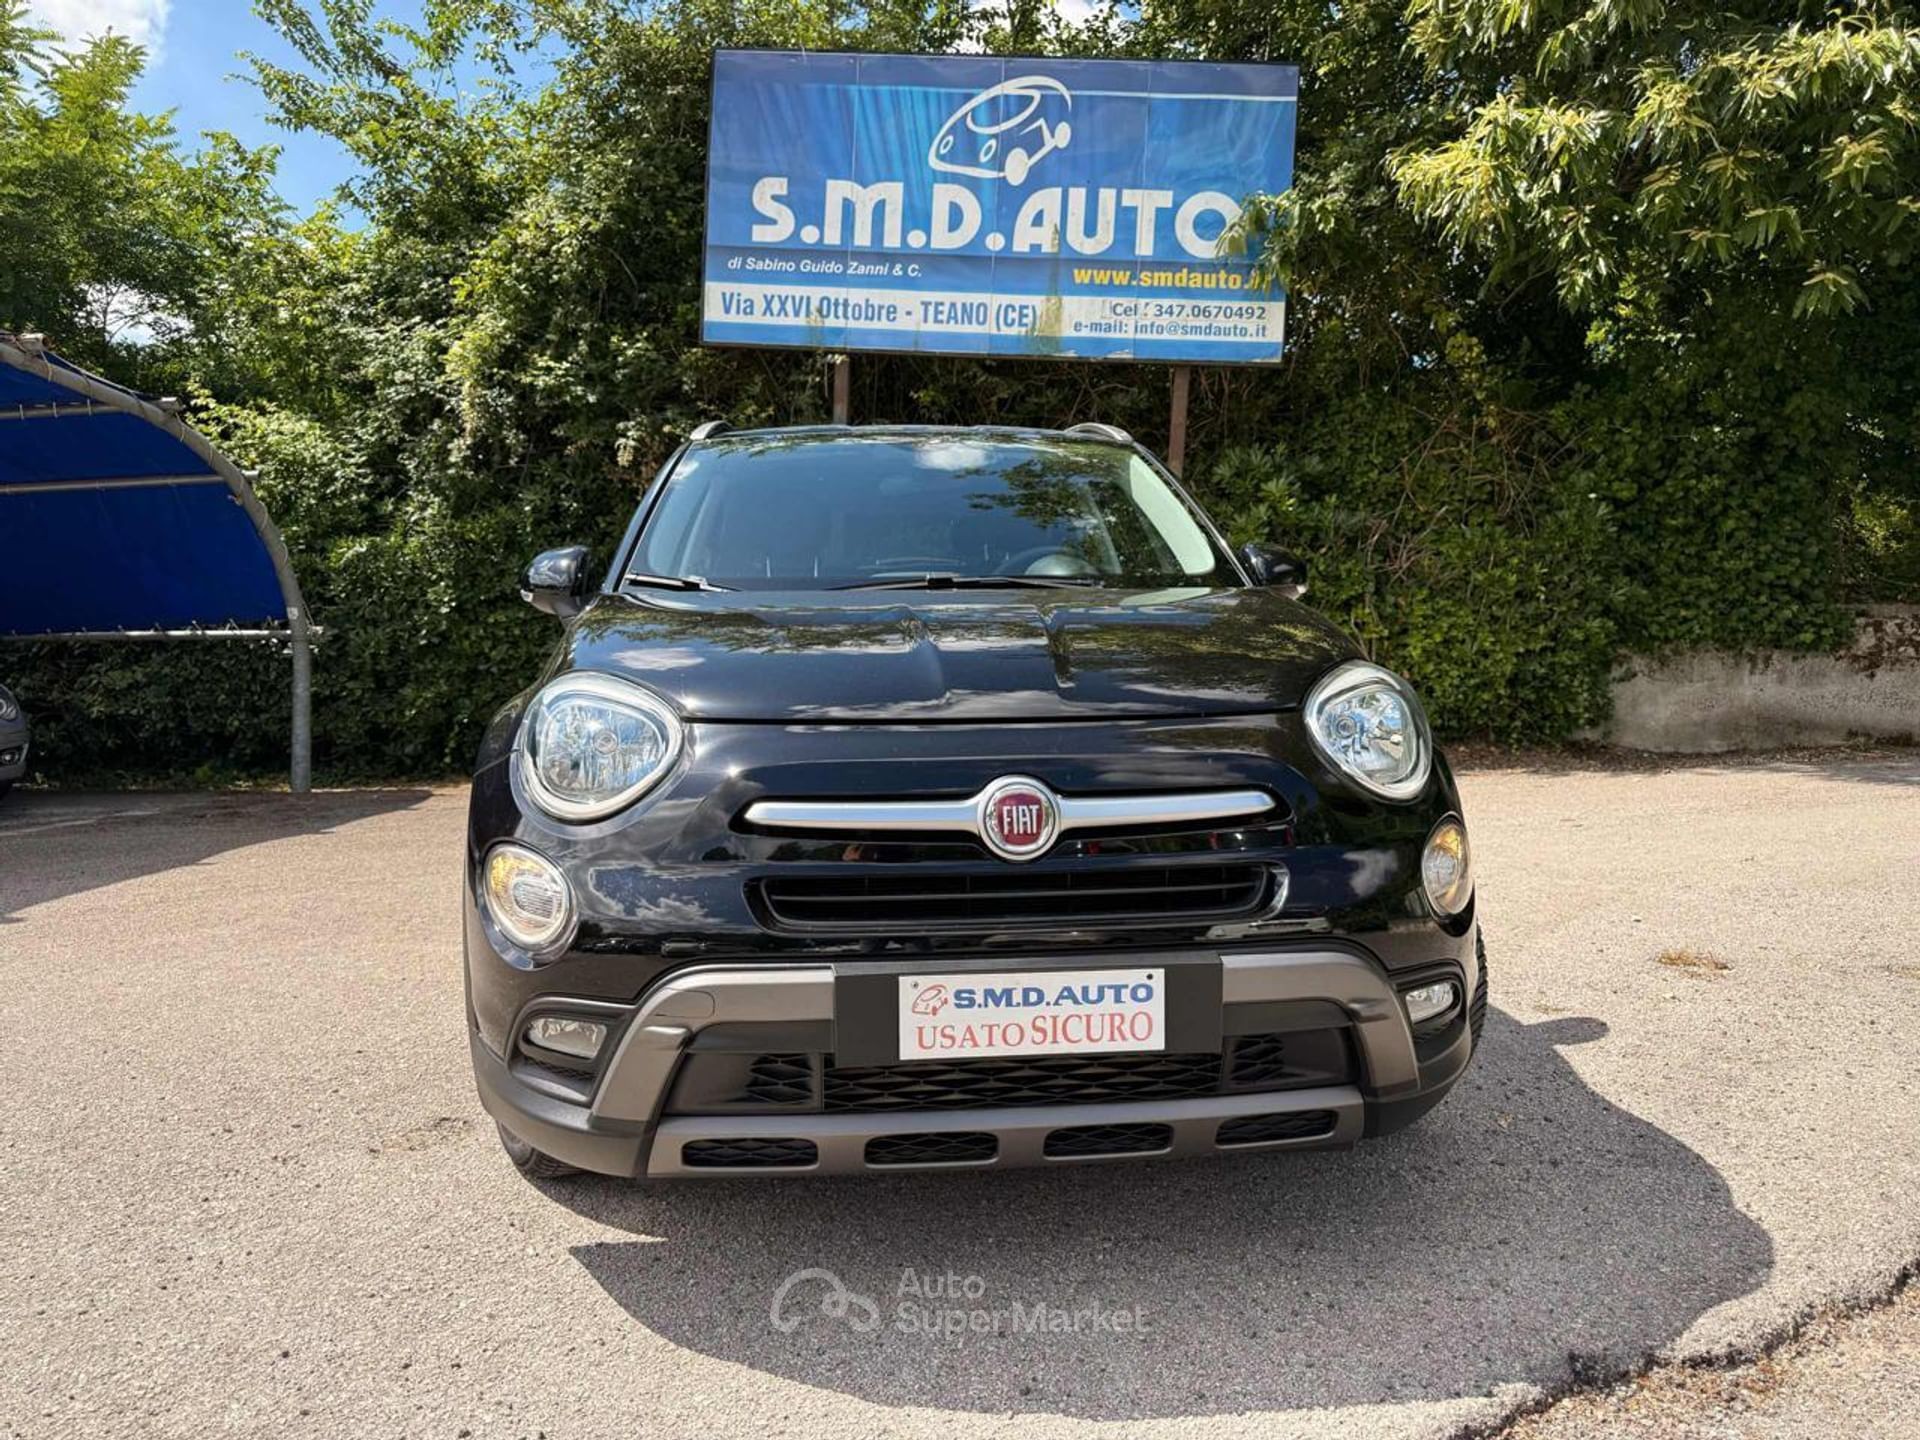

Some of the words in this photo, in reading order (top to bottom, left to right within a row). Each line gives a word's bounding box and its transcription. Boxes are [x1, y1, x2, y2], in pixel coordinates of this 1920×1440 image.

[751, 176, 1246, 260] S.M.D.AUTO
[727, 257, 742, 270] di
[745, 258, 796, 273] Sabino
[800, 260, 844, 274] Guido
[847, 262, 889, 276] Zanni
[892, 264, 904, 277] &
[907, 264, 923, 278] C.
[721, 291, 755, 317] Via
[762, 293, 812, 319] XXVI
[818, 295, 898, 322] Ottobre
[920, 301, 989, 326] TEANO
[995, 304, 1037, 332] (CE)
[1154, 304, 1267, 320] 347.0670492
[1073, 319, 1128, 334] e-mail:
[1134, 320, 1267, 338] info@smdauto.it
[1002, 805, 1040, 835] FIAT
[953, 983, 1154, 1009] S.M.D.AUTO
[916, 1023, 1025, 1050] USATO
[1031, 1011, 1153, 1046] SICURO
